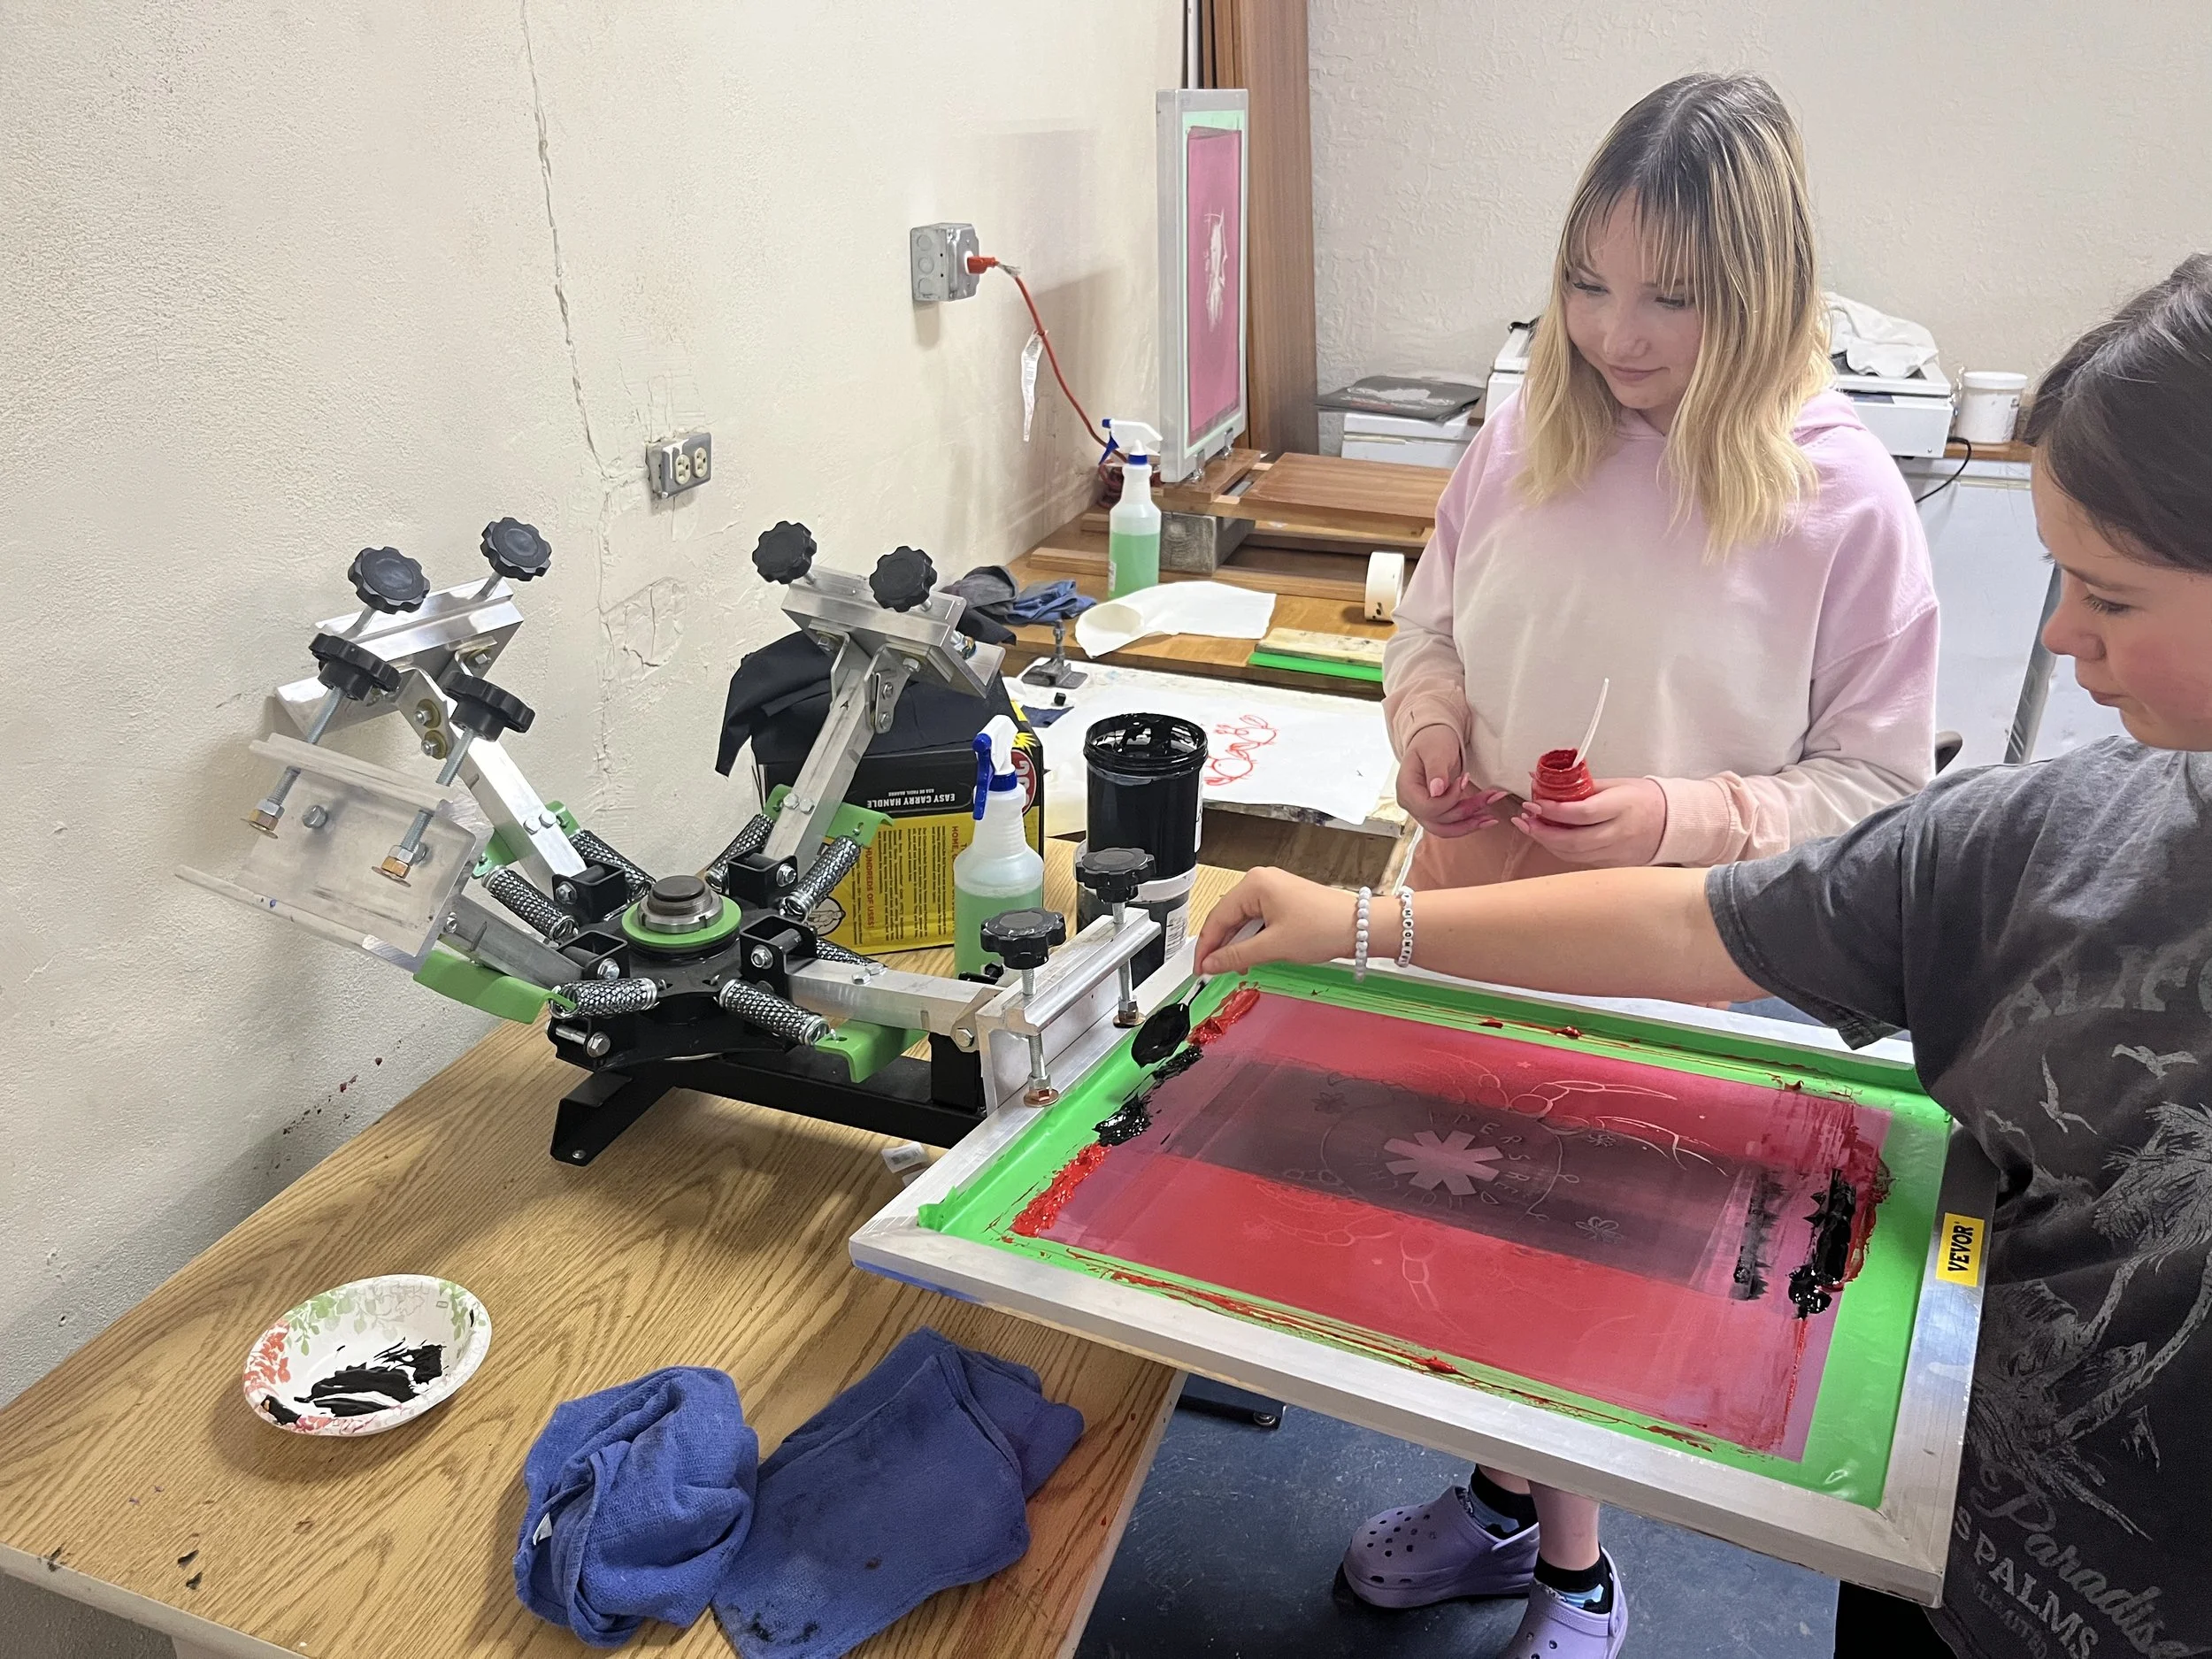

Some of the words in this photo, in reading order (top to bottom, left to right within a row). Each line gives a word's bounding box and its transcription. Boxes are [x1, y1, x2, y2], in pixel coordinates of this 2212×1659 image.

[867, 797, 902, 809] HANDLE
[902, 795, 932, 806] CARRY
[933, 794, 956, 803] EASY
[865, 847, 875, 893] HUNDREDS
[866, 893, 875, 904] OF
[1947, 1225, 1974, 1271] VEVOR
[1970, 1462, 2212, 1659] Paradise
[1973, 1530, 2099, 1659] PALMS
